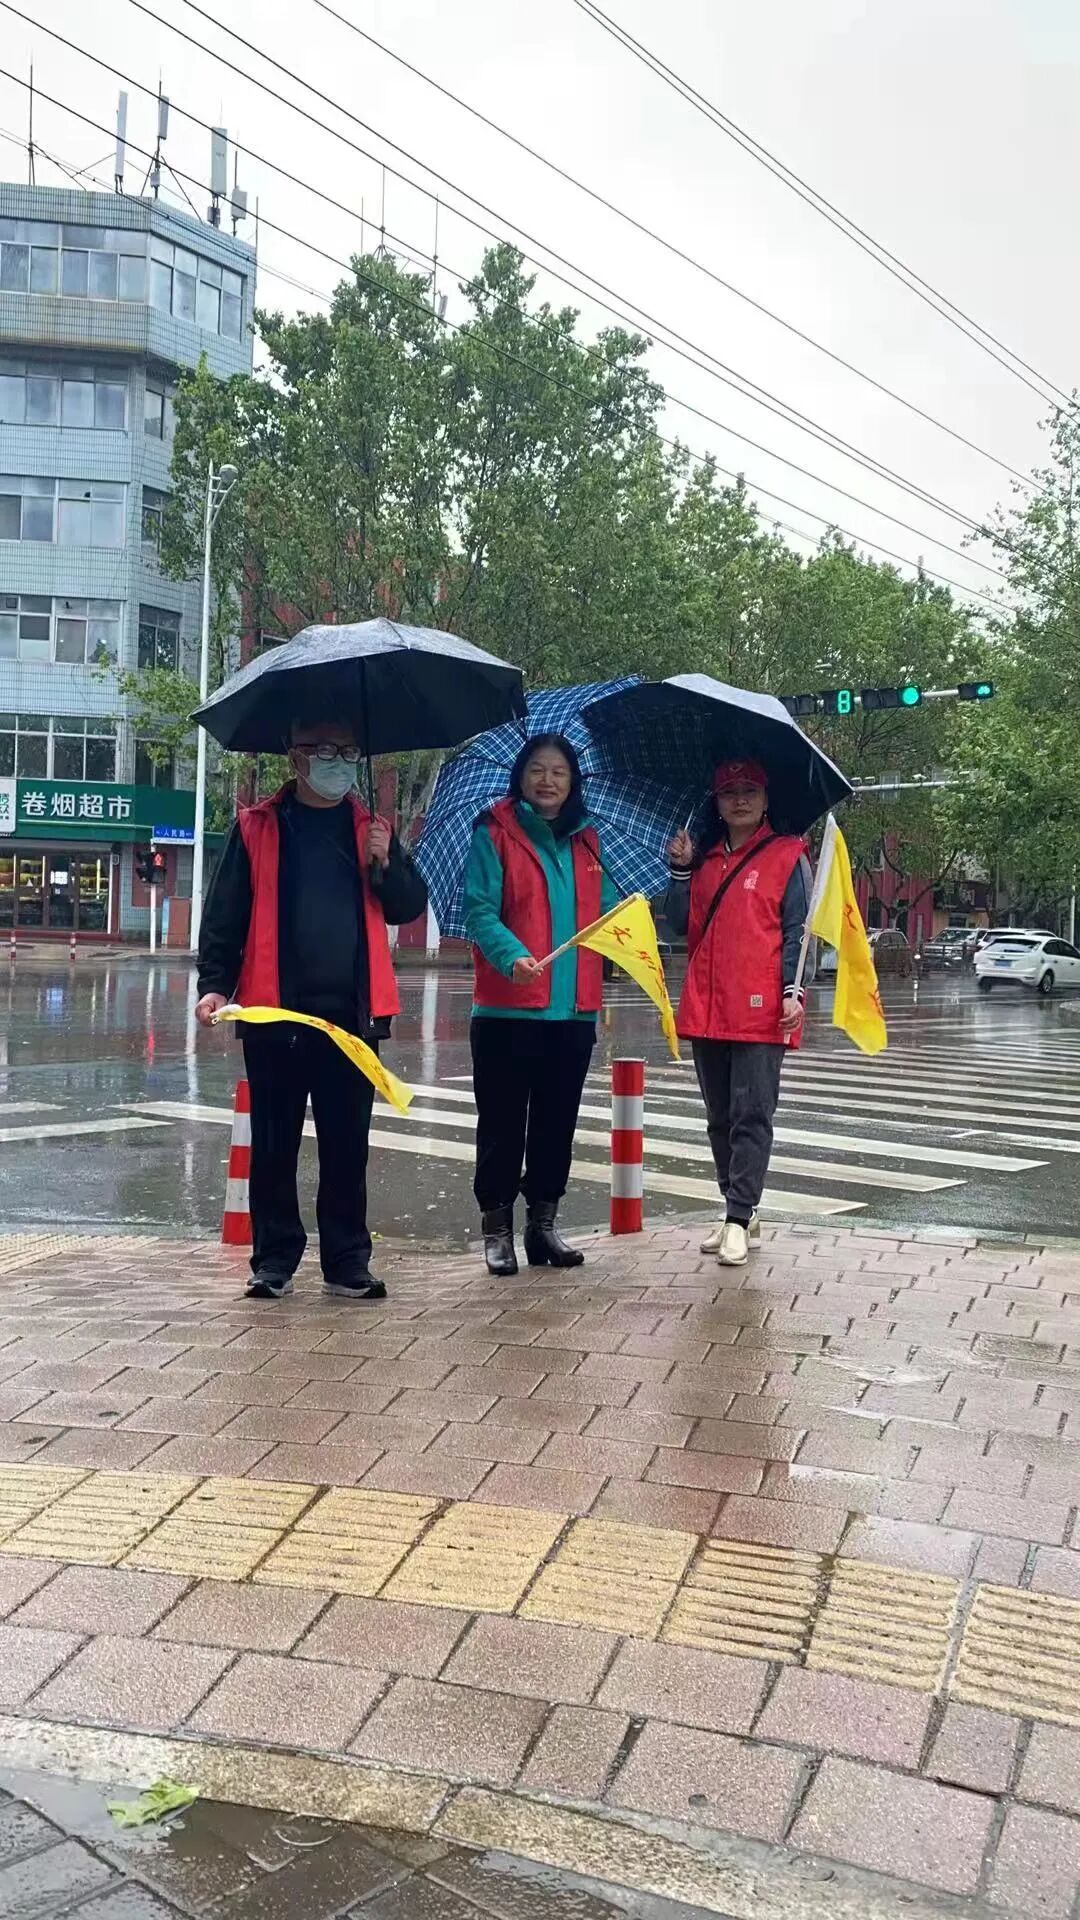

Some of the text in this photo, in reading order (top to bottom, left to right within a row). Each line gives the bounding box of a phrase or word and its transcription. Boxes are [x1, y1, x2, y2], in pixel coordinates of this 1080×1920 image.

[838, 690, 850, 713] 8
[21, 791, 133, 820] 卷烟超市
